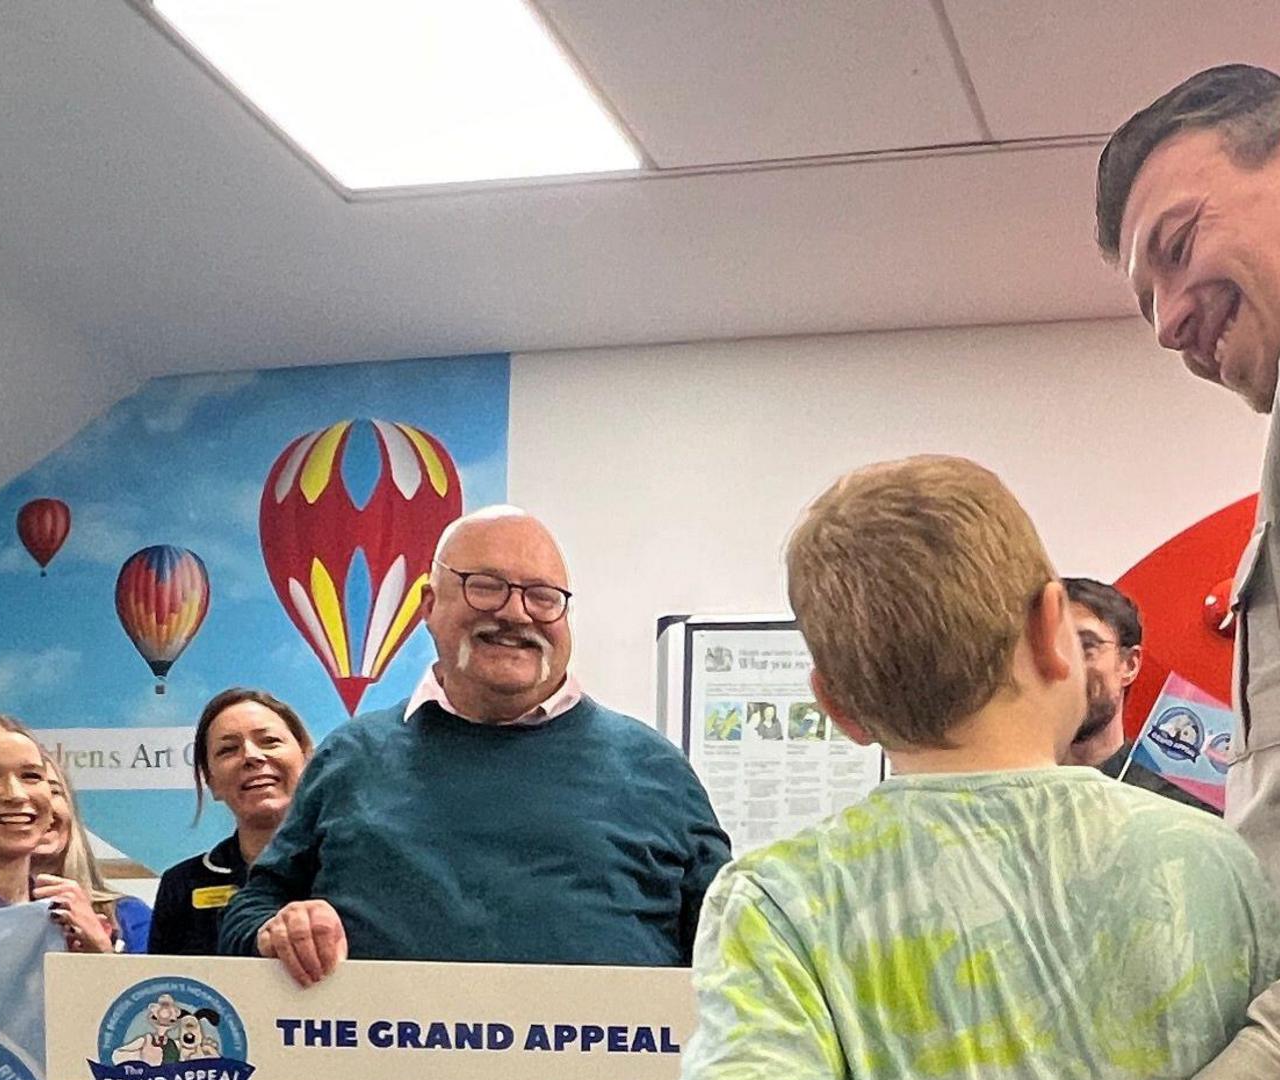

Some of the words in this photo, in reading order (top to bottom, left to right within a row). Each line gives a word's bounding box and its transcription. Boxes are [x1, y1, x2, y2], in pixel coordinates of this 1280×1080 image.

[131, 743, 174, 768] Art
[277, 1017, 359, 1049] THE
[368, 1020, 515, 1051] GRAND
[523, 1023, 681, 1054] APPEAL
